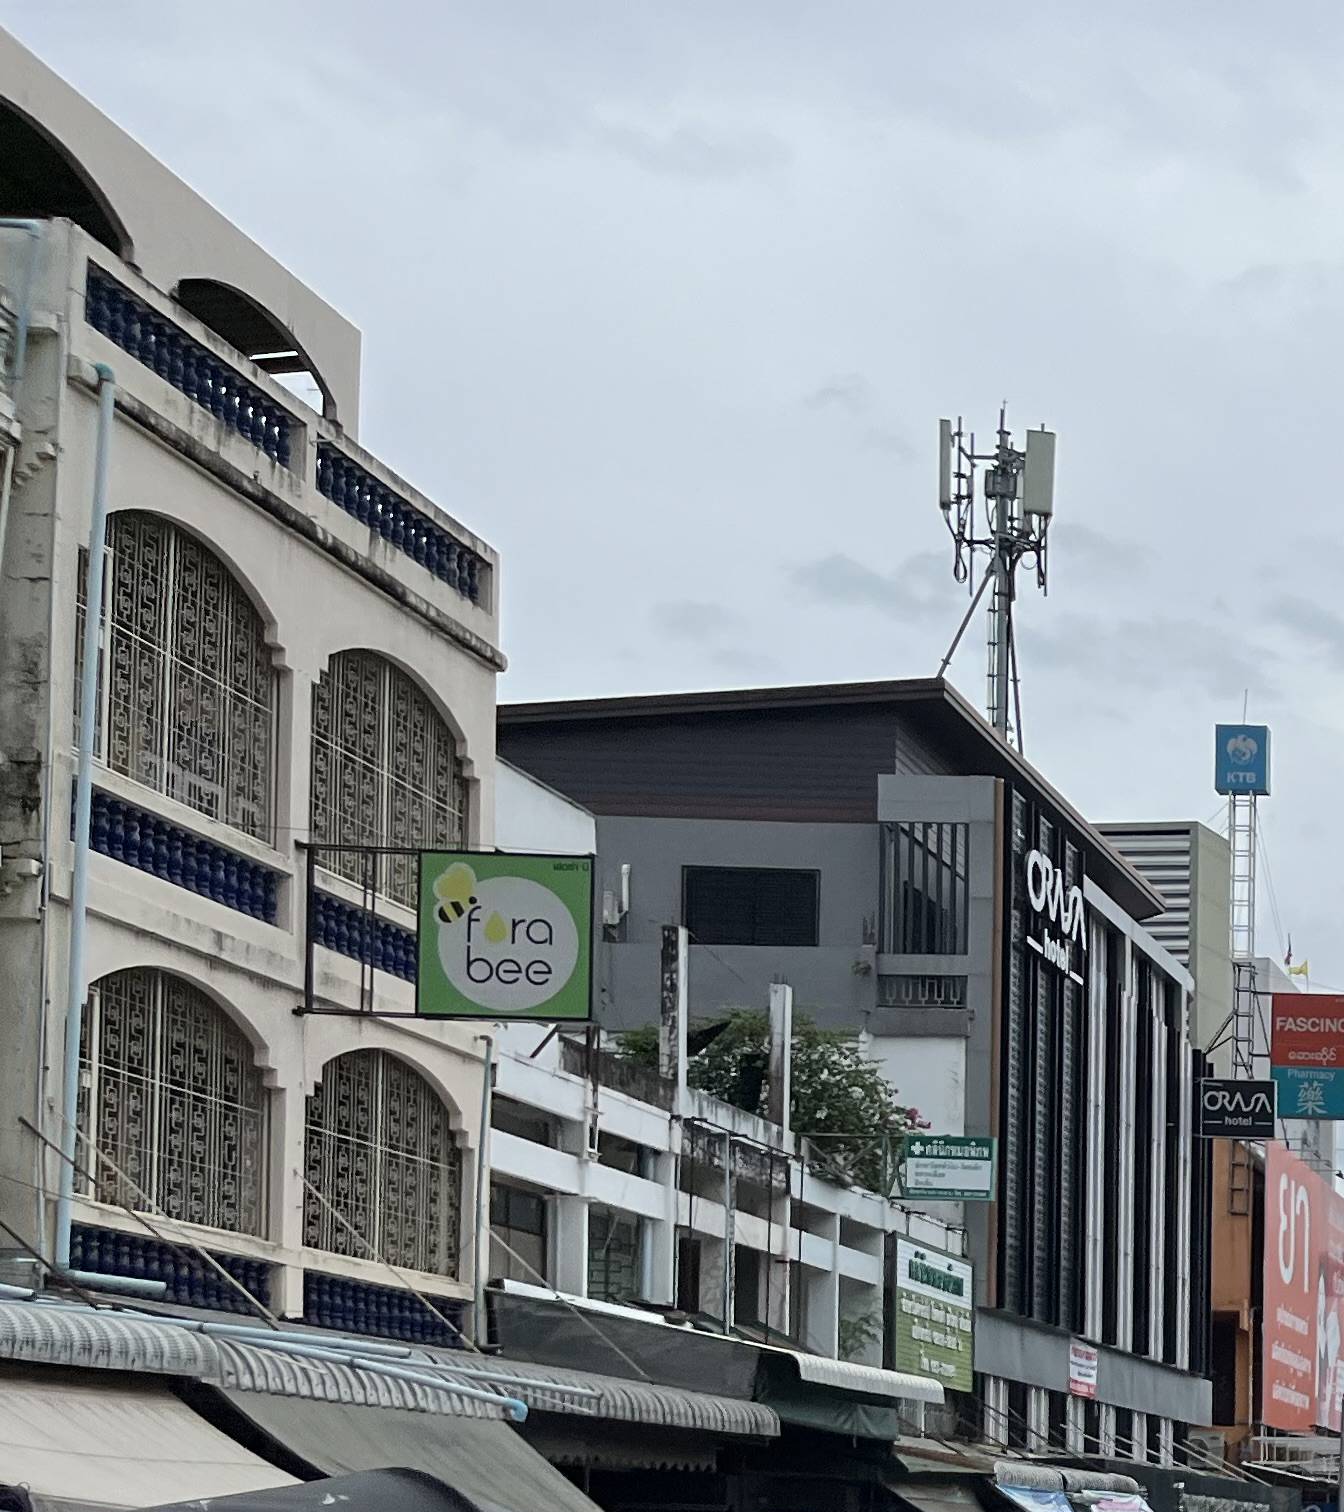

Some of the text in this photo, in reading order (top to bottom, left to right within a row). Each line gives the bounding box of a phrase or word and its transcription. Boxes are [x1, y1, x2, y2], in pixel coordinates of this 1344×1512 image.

[1227, 772, 1256, 783] KTB
[466, 945, 553, 986] bee
[1044, 928, 1069, 974] hotel
[1287, 1069, 1336, 1082] Pharmacy
[1296, 1081, 1327, 1115] 藥
[1224, 1116, 1253, 1126] hotel
[1278, 1173, 1310, 1294] ยา
